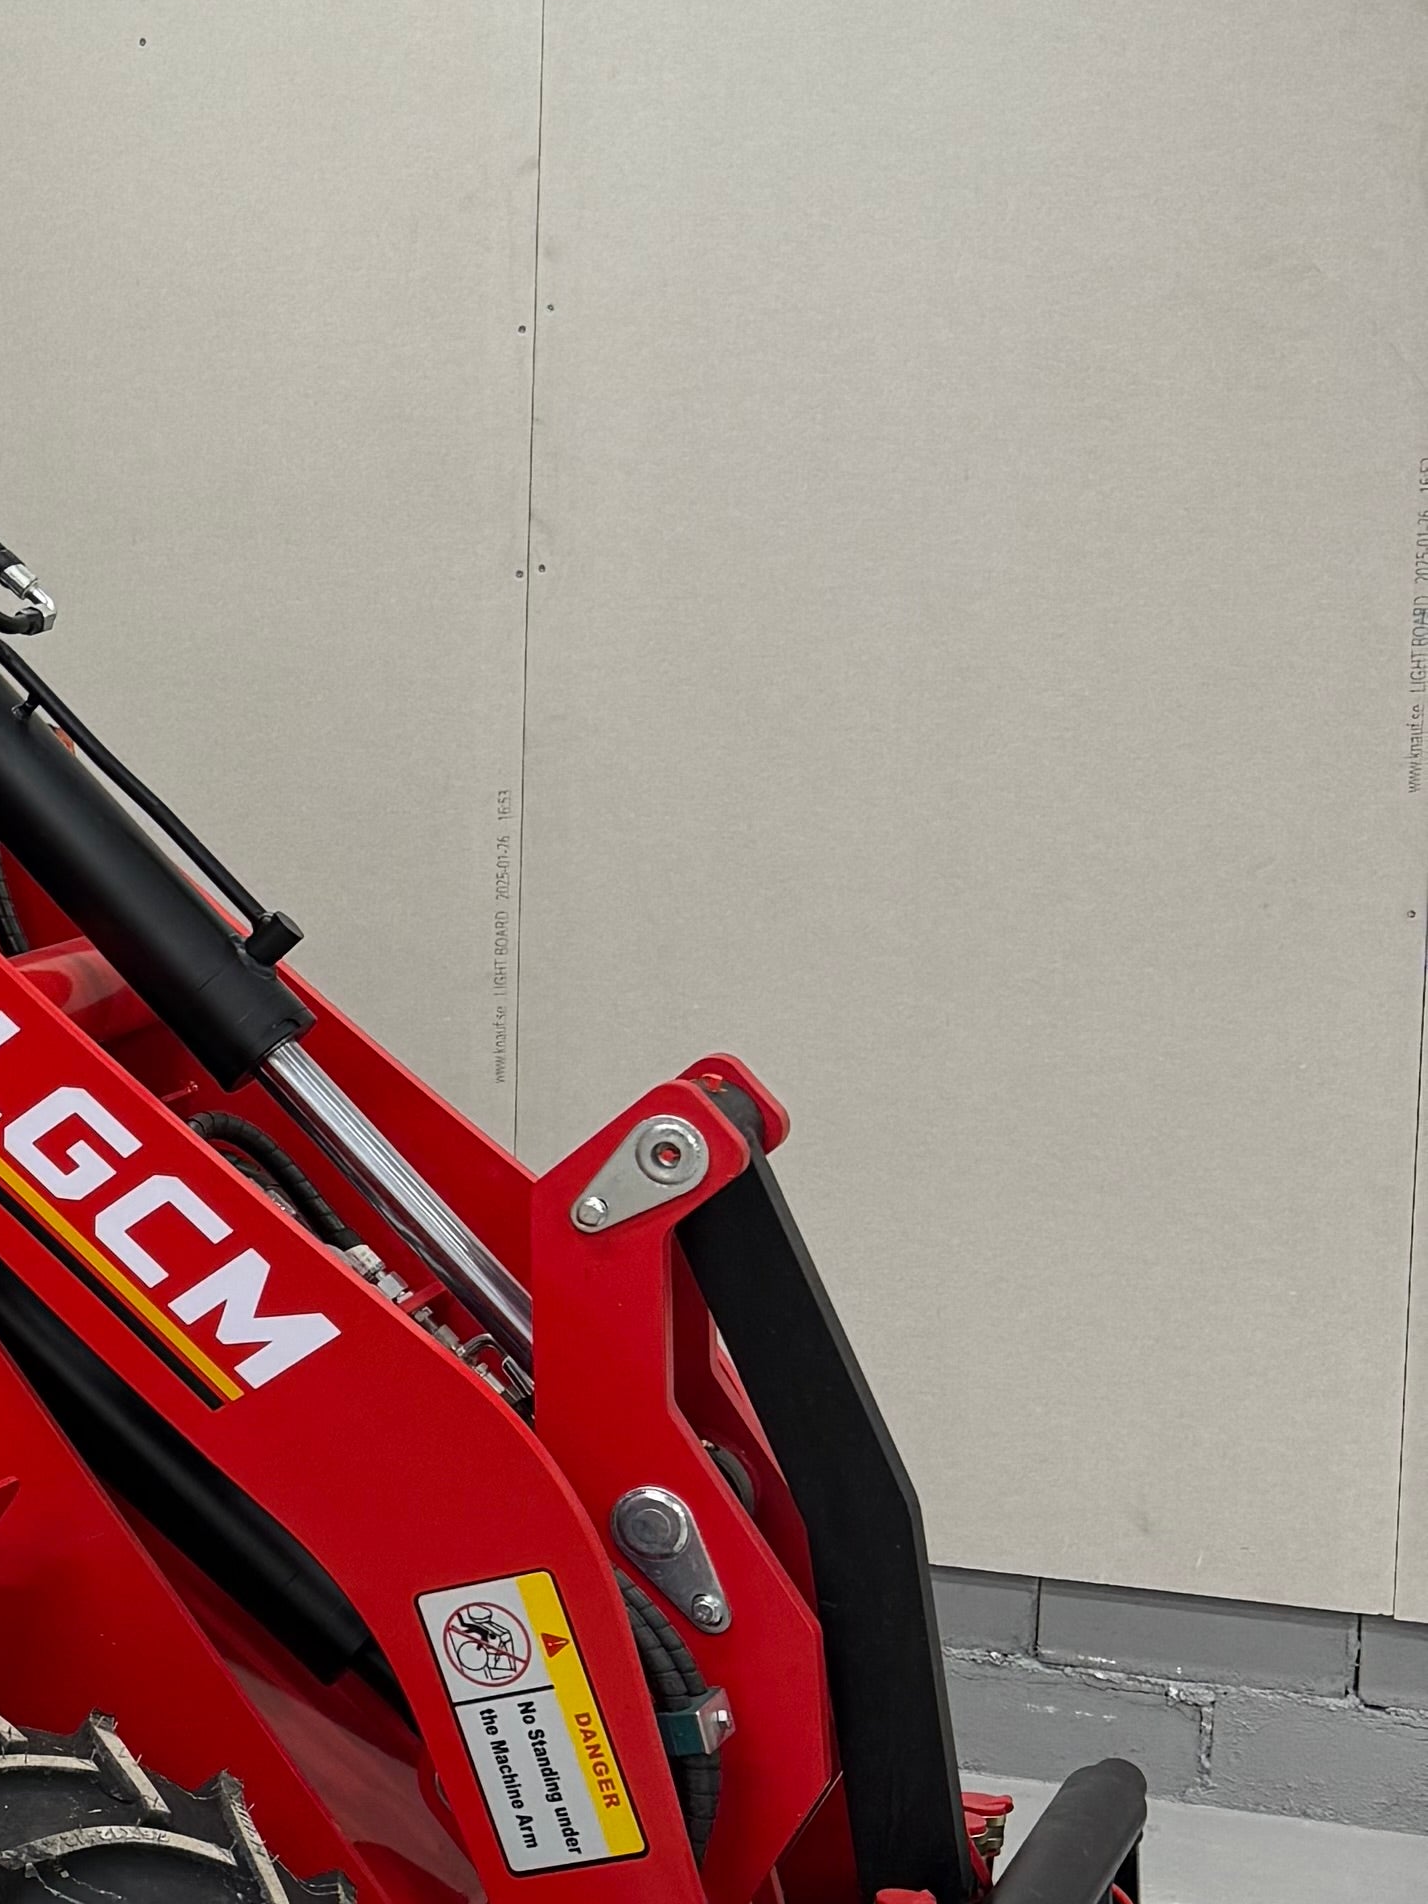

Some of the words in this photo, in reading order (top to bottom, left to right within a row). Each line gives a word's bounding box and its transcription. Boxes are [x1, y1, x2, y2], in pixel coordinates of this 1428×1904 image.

[1409, 650, 1426, 693] LIGHT
[494, 911, 509, 956] BOARD
[494, 959, 507, 996] LIGHT
[479, 1708, 499, 1736] the
[490, 1740, 524, 1809] Machine
[515, 1814, 538, 1849] Arm
[517, 1701, 536, 1725] No
[528, 1729, 563, 1803] Standing
[554, 1807, 582, 1855] under
[574, 1712, 621, 1809] DANGER
